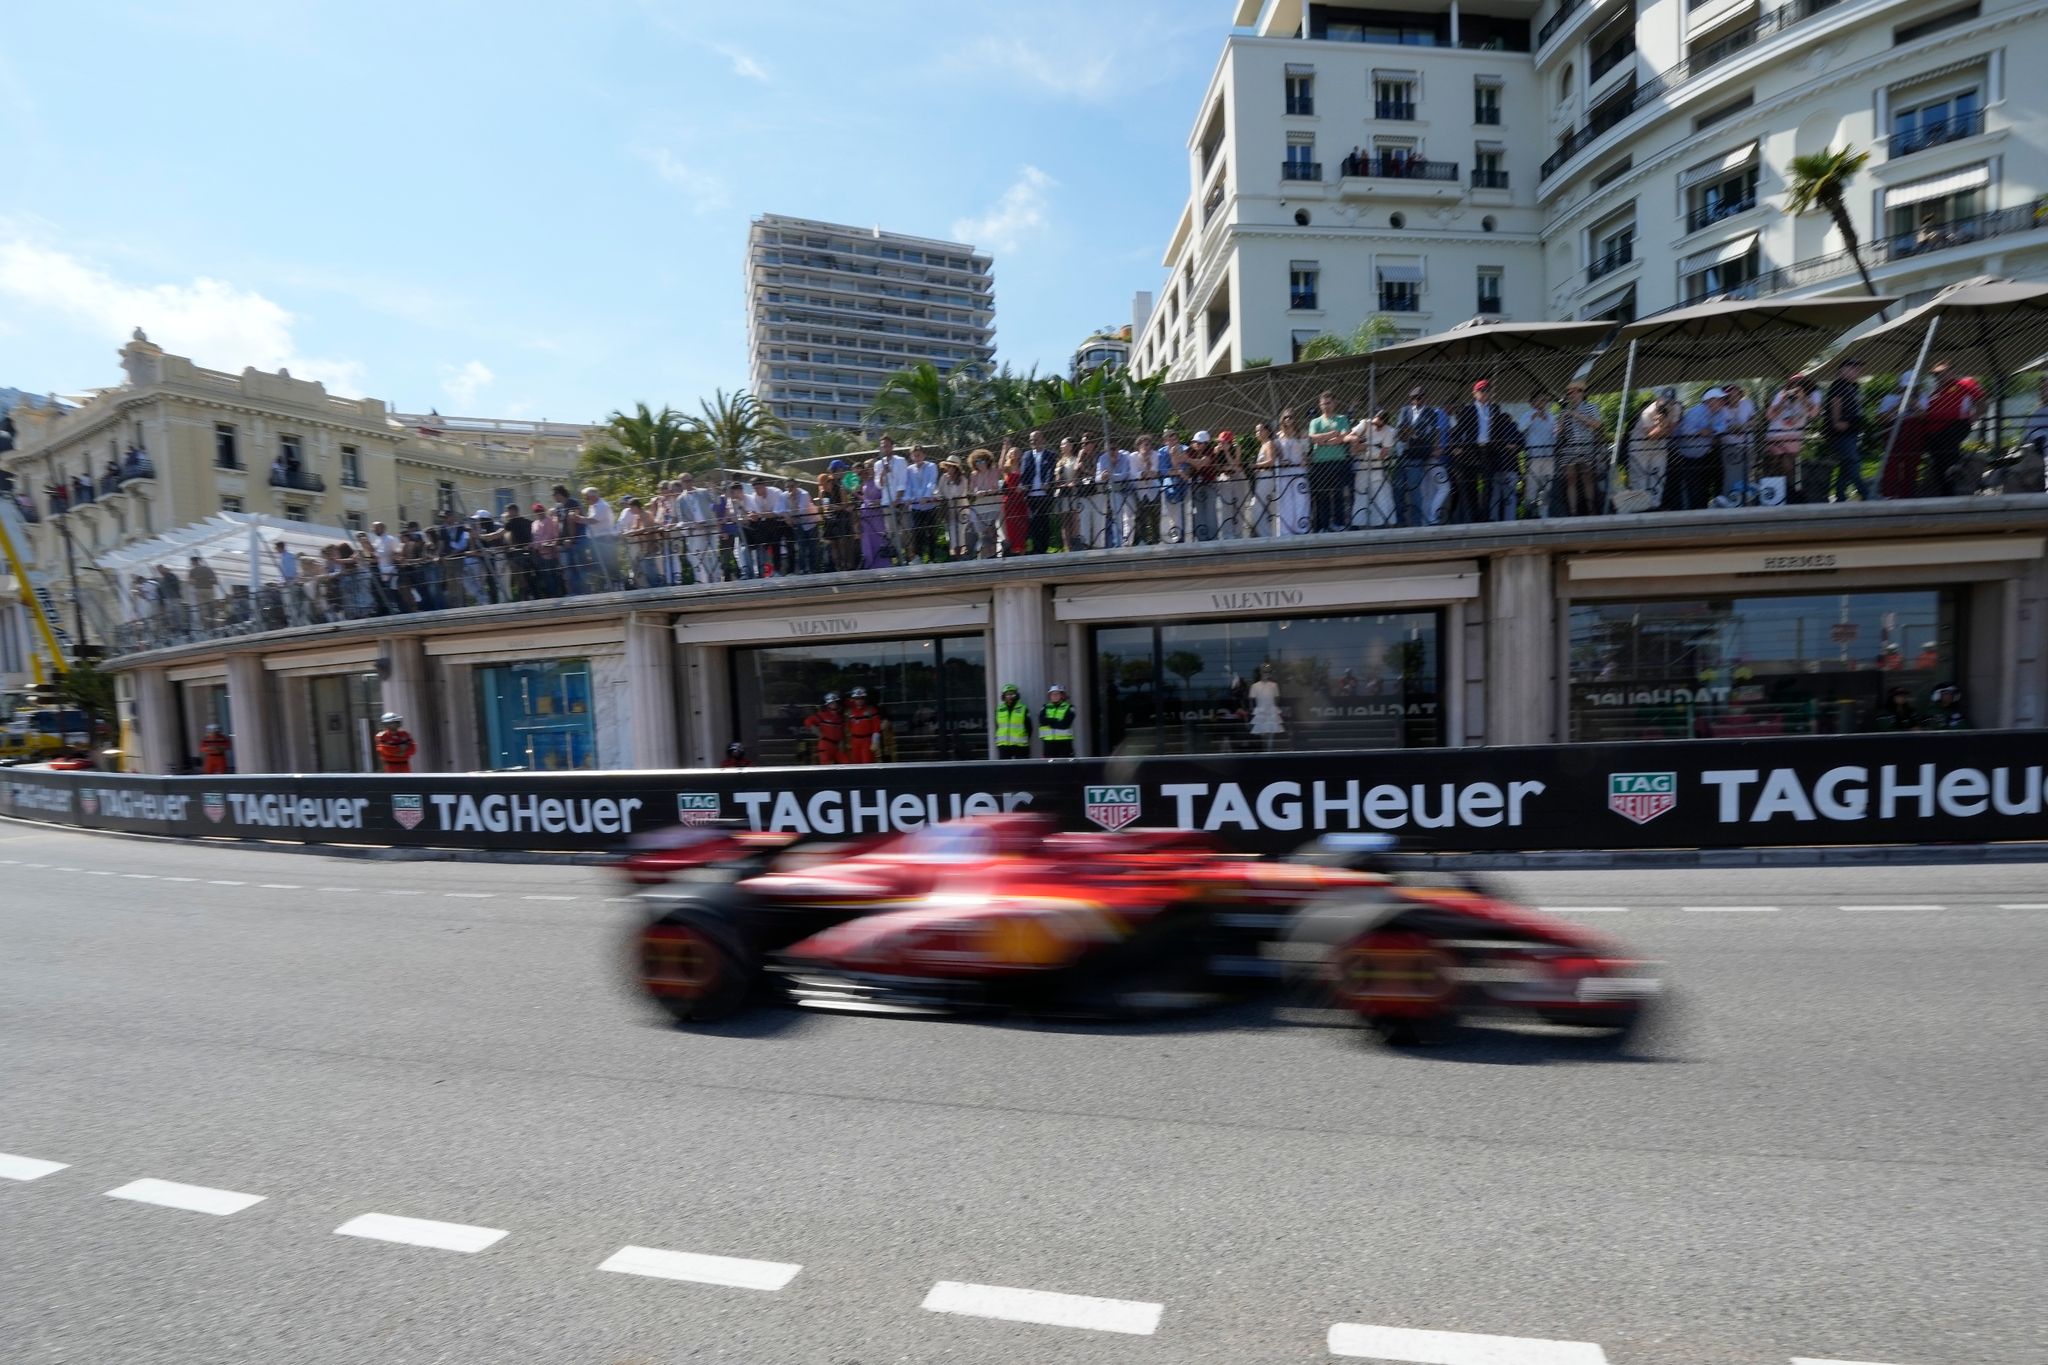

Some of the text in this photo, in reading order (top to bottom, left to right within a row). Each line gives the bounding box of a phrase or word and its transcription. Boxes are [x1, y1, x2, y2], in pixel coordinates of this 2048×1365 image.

[1211, 589, 1303, 609] VALENTINO
[788, 618, 858, 634] VALENTINO
[1614, 776, 1670, 791] TAG
[1700, 762, 2048, 823] TAGHeu
[681, 796, 715, 808] TAG
[1089, 788, 1135, 802] TAG
[1613, 795, 1673, 819] HEUER
[1089, 806, 1137, 827] HEUER
